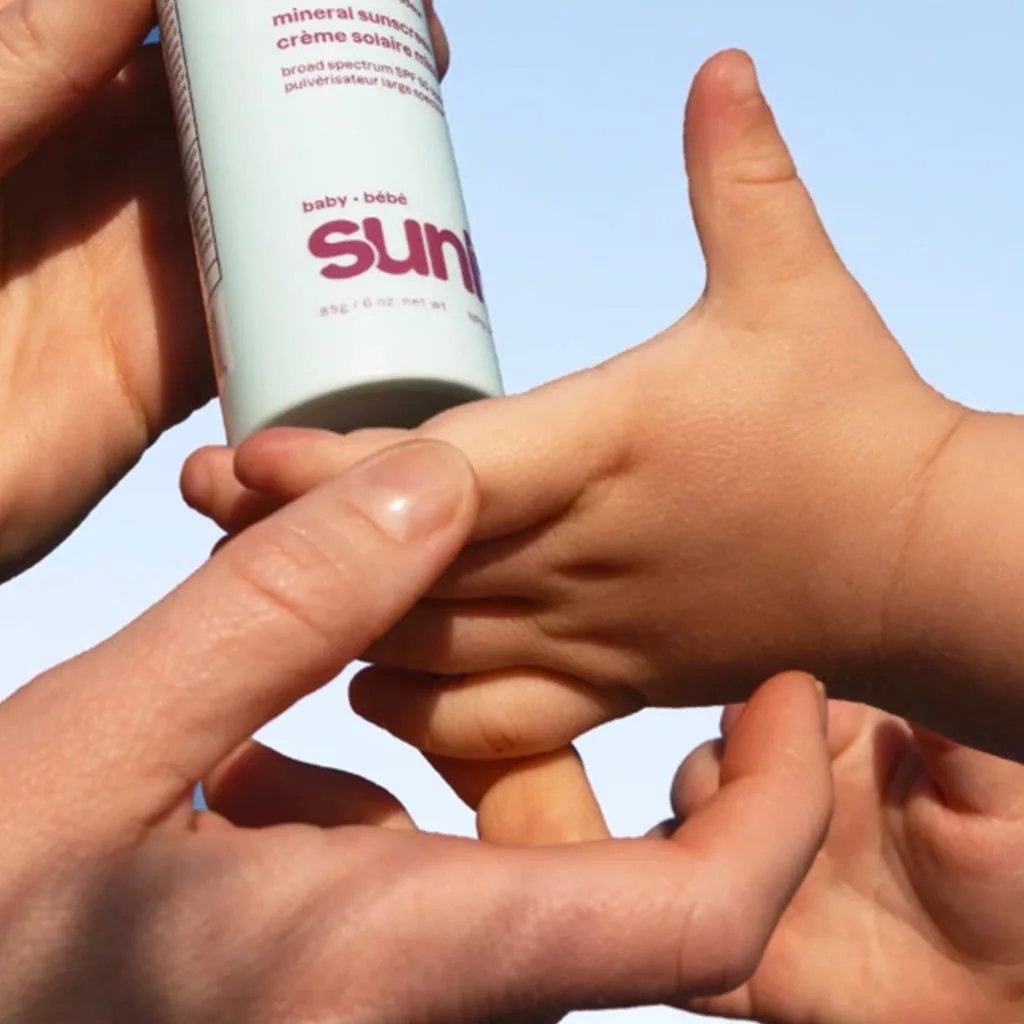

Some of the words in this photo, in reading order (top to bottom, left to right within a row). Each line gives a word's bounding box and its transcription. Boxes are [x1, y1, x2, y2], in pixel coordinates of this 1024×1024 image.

[272, 6, 354, 27] mineral
[276, 30, 347, 50] crème
[351, 32, 413, 58] solaire
[281, 60, 325, 78] broad
[327, 60, 394, 75] spectrum
[302, 196, 347, 214] baby
[363, 191, 409, 206] bébé
